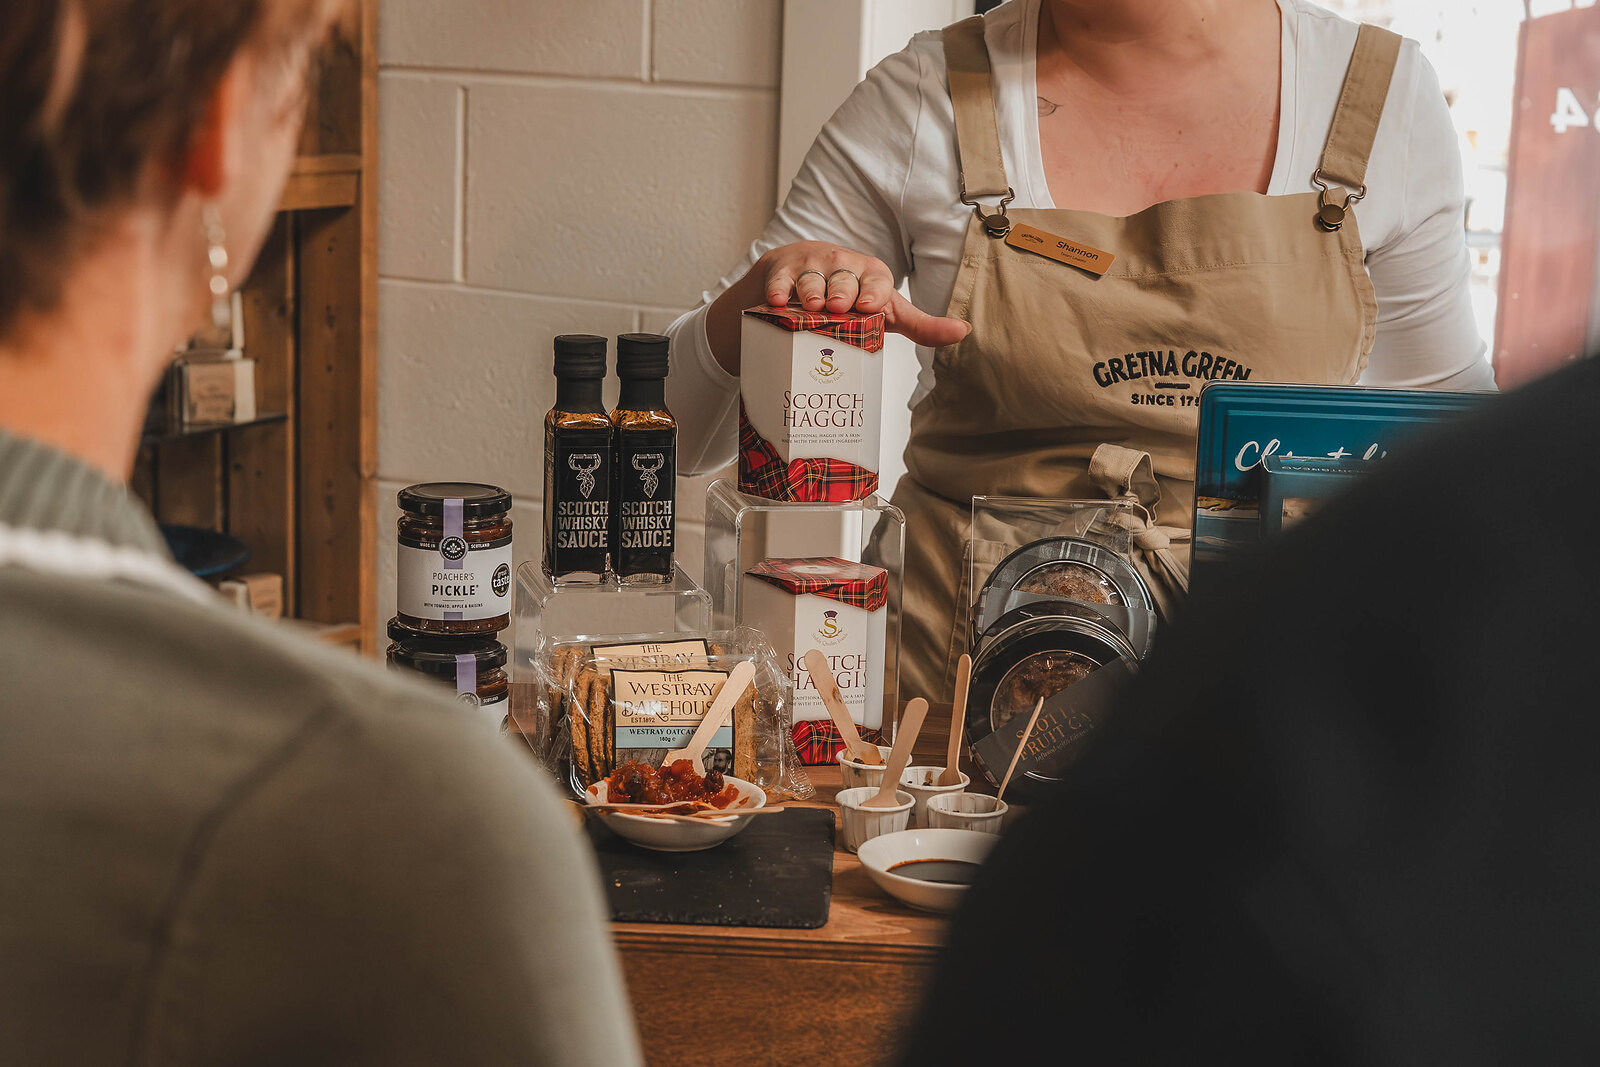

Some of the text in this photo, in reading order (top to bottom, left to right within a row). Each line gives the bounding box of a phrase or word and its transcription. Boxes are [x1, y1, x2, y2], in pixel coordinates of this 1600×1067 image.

[1056, 240, 1099, 260] Shannon
[1092, 350, 1252, 388] GRETNA GREEN
[783, 390, 864, 410] SCOTCH
[1130, 393, 1200, 406] SINCE 179
[783, 410, 864, 428] HAGGIS
[558, 500, 609, 515] SCOTCH
[622, 500, 672, 515] SCOTCH
[558, 516, 608, 530] WHISKY
[622, 516, 672, 530] WHISKY
[558, 530, 608, 548] SAUCE
[622, 530, 672, 548] SAUCE
[433, 572, 474, 581] POACHER'S
[493, 576, 510, 588] taste
[640, 644, 662, 653] THE
[609, 653, 694, 668] WESTRAY
[786, 652, 866, 671] SCTCH
[662, 674, 683, 682] THE
[787, 671, 866, 690] HAGIS
[628, 682, 716, 696] WESTRAY
[622, 701, 715, 722] BAKEHOUS
